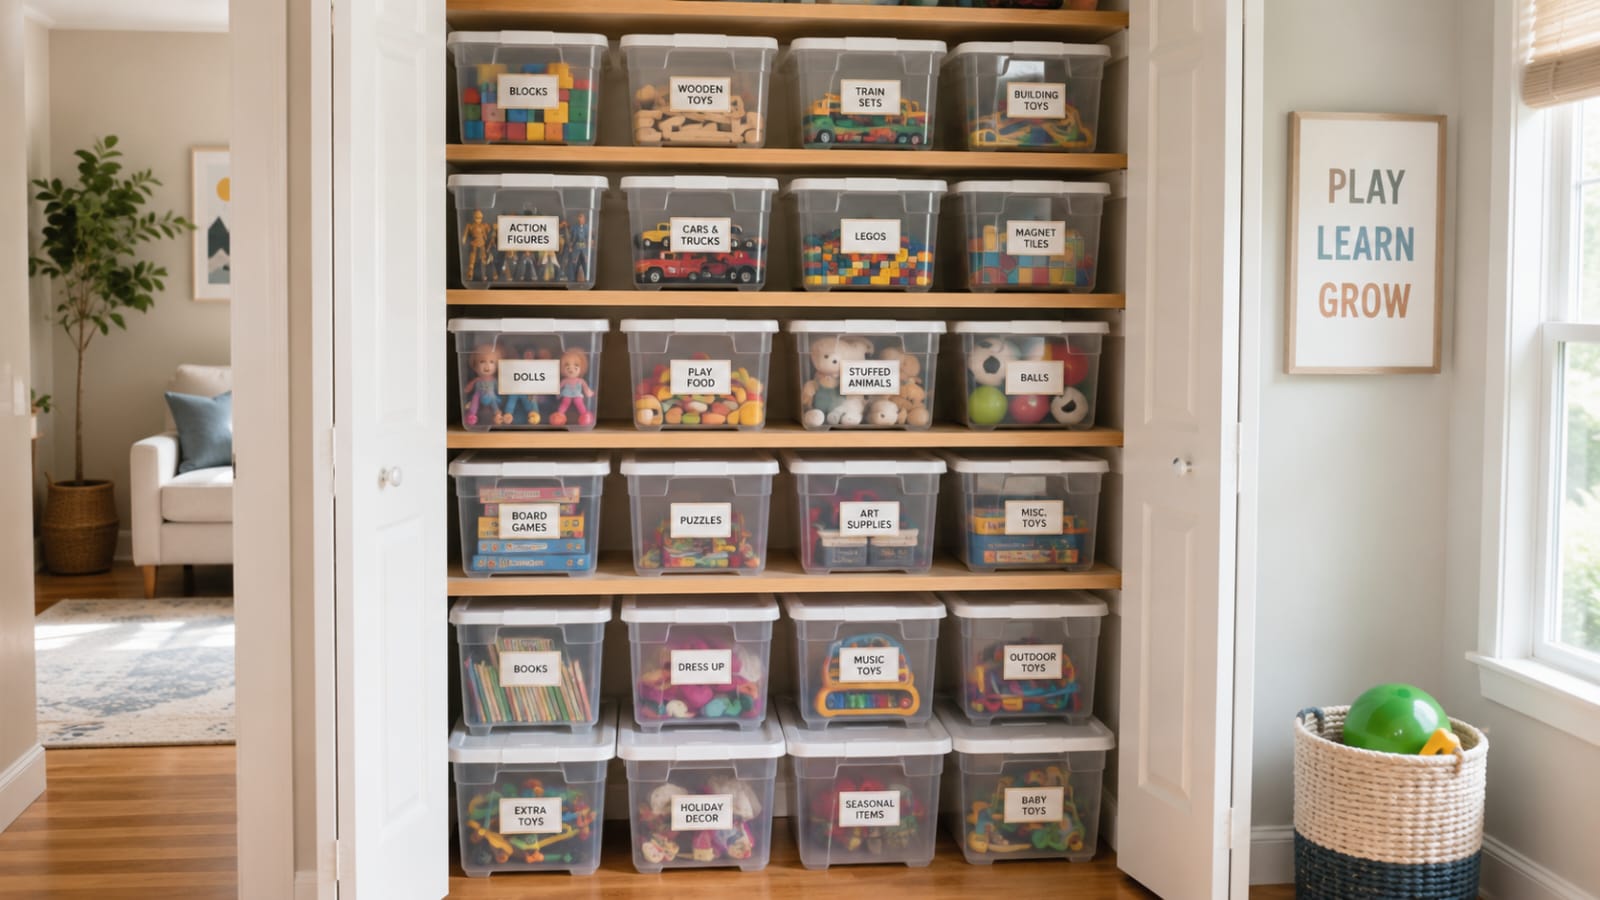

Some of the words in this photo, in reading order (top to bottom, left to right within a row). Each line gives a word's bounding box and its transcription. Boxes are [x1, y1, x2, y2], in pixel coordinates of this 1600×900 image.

[509, 86, 548, 96] BLOCKS
[677, 84, 723, 94] WOODEN
[855, 87, 885, 96] TRAIN
[1014, 89, 1059, 100] BUILDING
[687, 96, 713, 105] TOYS
[859, 98, 882, 107] SETS
[1024, 101, 1049, 111] TOYS
[1328, 169, 1406, 204] PLAY
[509, 223, 547, 233] ACTION
[682, 225, 709, 234] CARS
[711, 225, 718, 234] &
[1015, 228, 1056, 237] MAGNET
[507, 235, 550, 244] FIGURES
[681, 236, 720, 246] TRUCKS
[855, 232, 886, 241] LEGOS
[1023, 239, 1049, 249] TILES
[1317, 226, 1414, 261] LEARN
[1319, 282, 1411, 318] GROW
[688, 368, 712, 376] PLAY
[849, 367, 891, 376] STUFFED
[513, 372, 546, 381] DOLLS
[1021, 373, 1049, 382] BALLS
[687, 378, 715, 387] FOOD
[848, 379, 891, 388] ANIMALS
[512, 511, 547, 520] BOARD
[860, 509, 879, 518] ART
[1021, 508, 1047, 517] MISC.
[680, 516, 722, 525] PUZZLES
[847, 520, 892, 529] SUPPLIES
[1022, 518, 1047, 528] TOYS
[512, 523, 547, 532] GAMES
[854, 655, 884, 664] MUSIC
[1009, 652, 1057, 662] OUTDOOR
[514, 664, 548, 673] BOOKS
[678, 663, 709, 671] DRESS
[711, 663, 725, 671] UP
[857, 666, 882, 675] TOYS
[1021, 663, 1046, 673] TOYS
[846, 800, 895, 808] SEASONAL
[1022, 796, 1047, 805] BABY
[514, 806, 546, 815] EXTRA
[681, 803, 723, 812] HOLIDAY
[1022, 806, 1047, 815] TOYS
[686, 814, 719, 823] DECOR
[856, 810, 884, 819] ITEMS
[518, 817, 544, 826] TOYS
